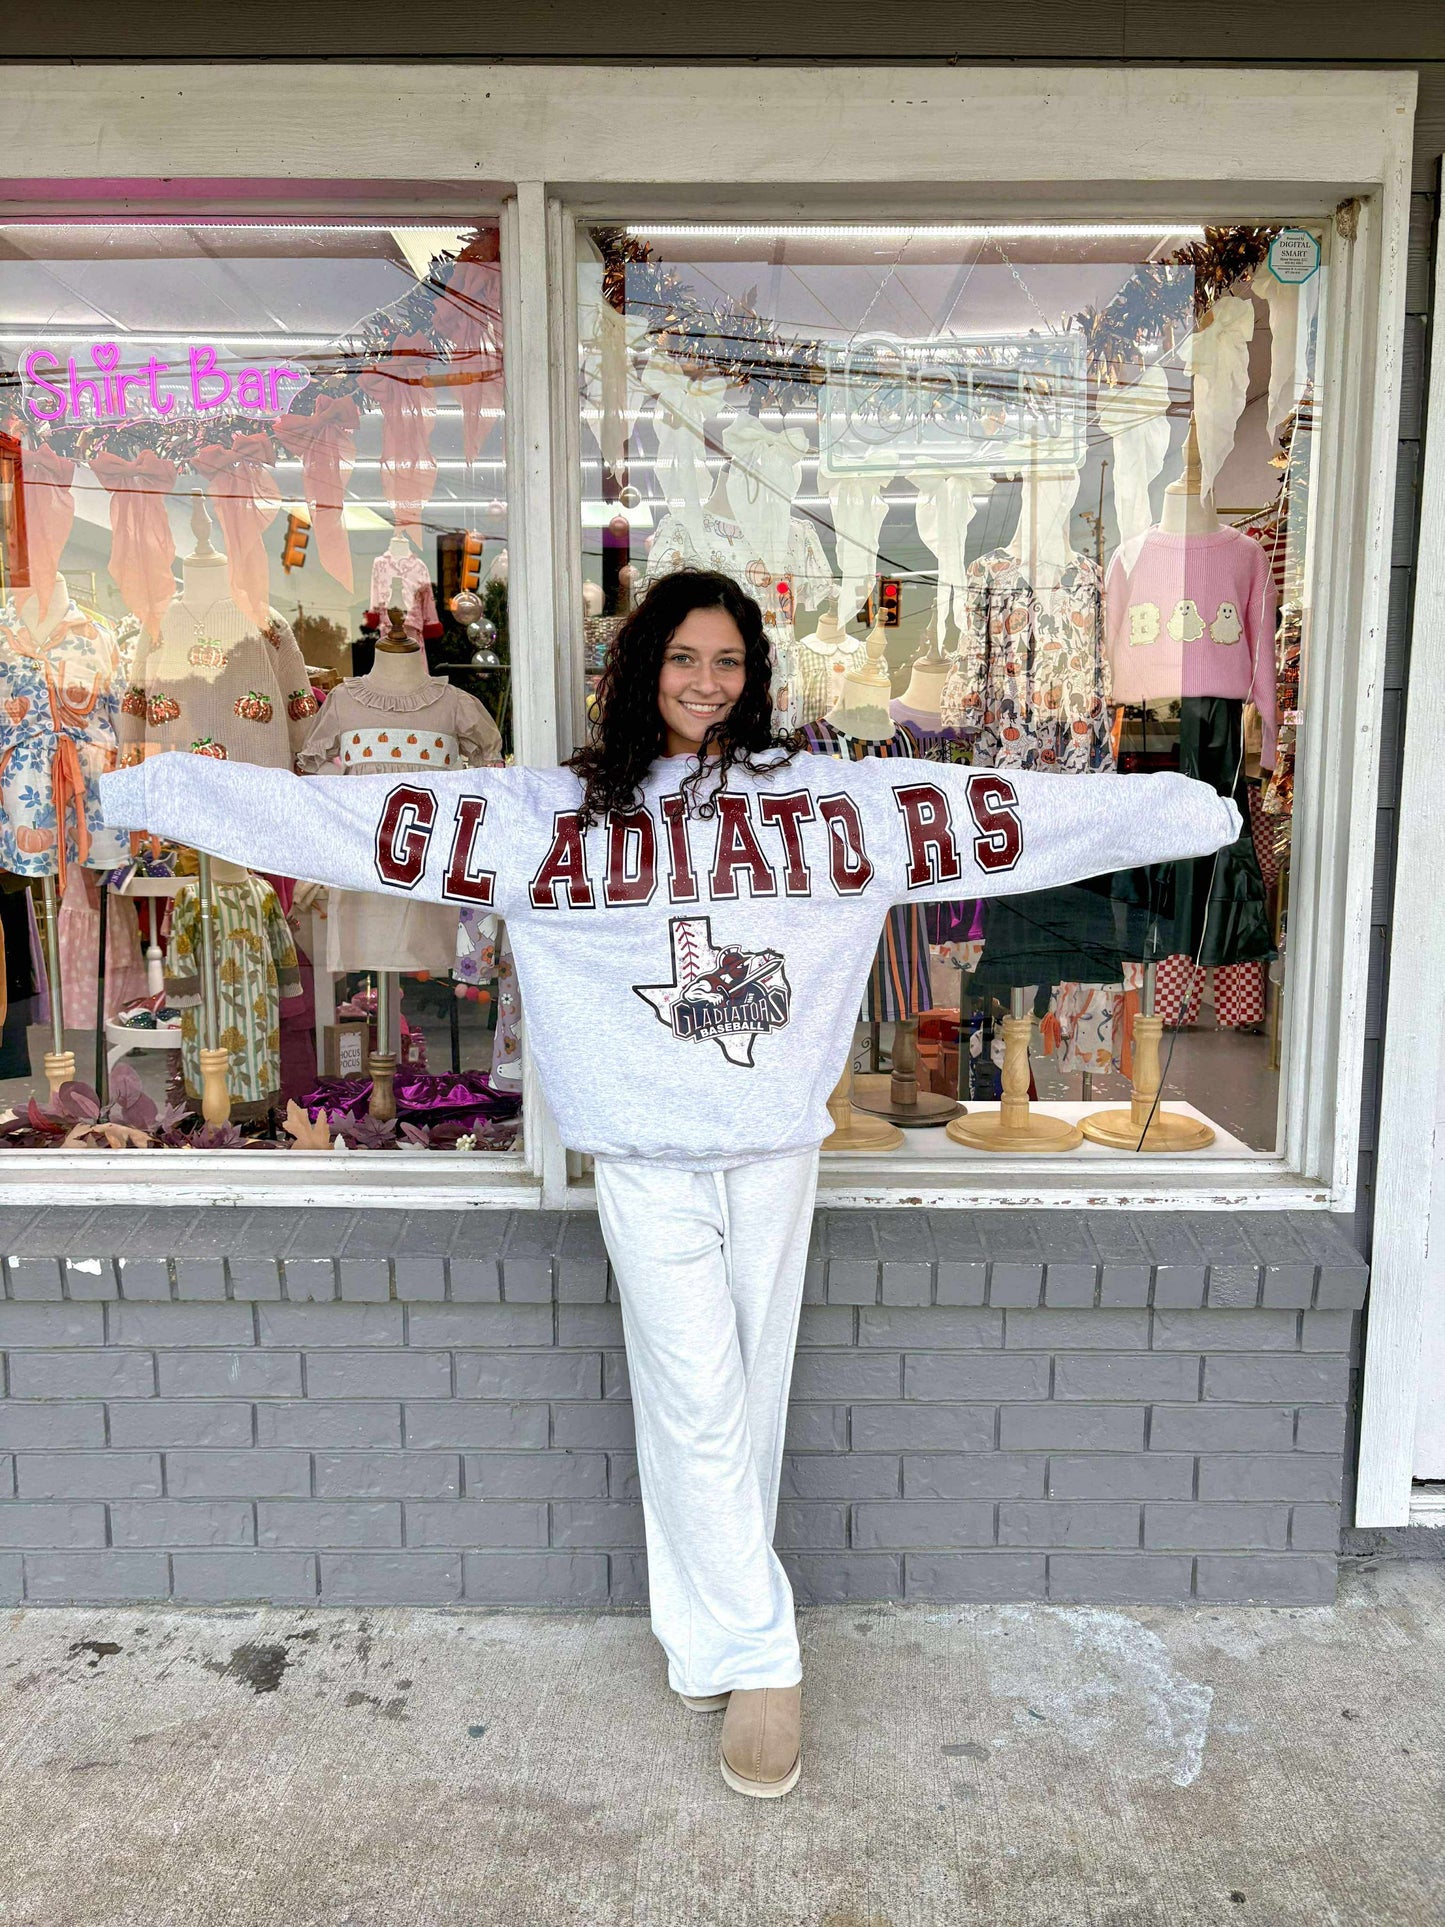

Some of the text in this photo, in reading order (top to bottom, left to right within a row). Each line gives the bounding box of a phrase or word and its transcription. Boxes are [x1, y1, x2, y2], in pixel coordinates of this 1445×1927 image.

[25, 342, 301, 421] Shirt Bar
[671, 989, 789, 1038] GLADIATORS
[700, 1020, 765, 1038] BASEBALL
